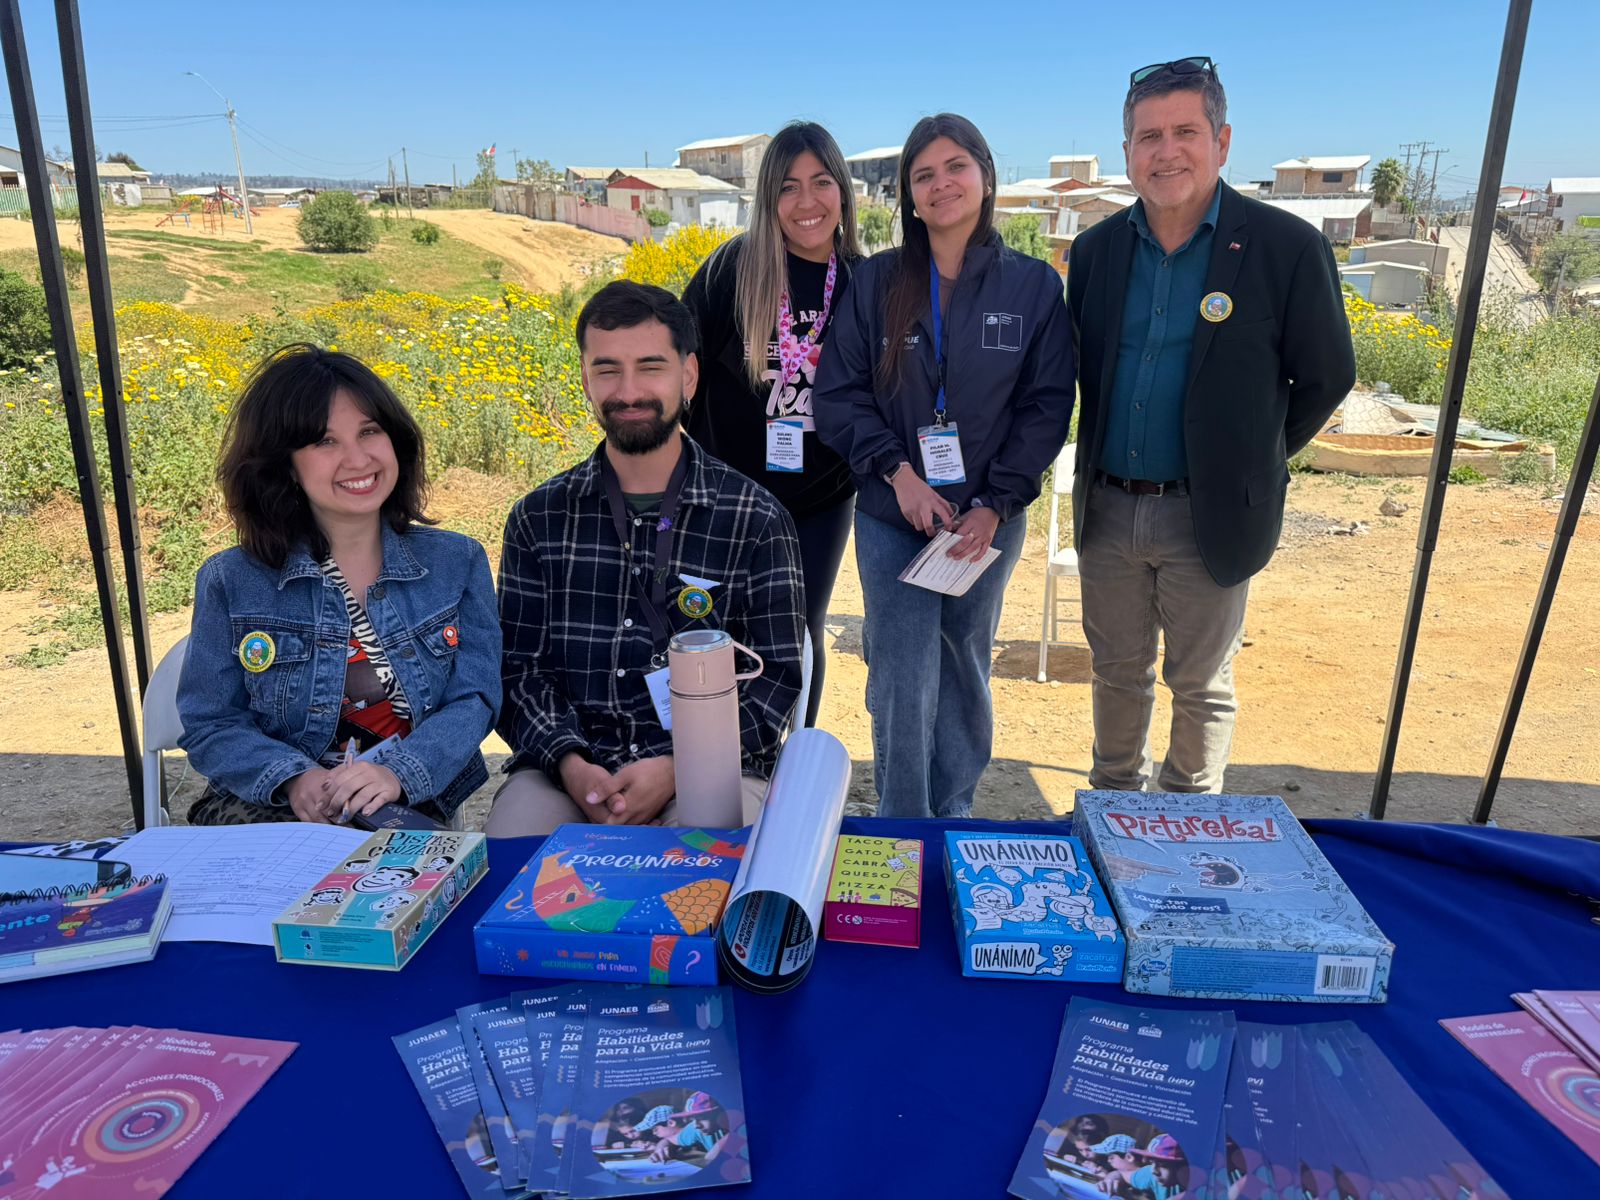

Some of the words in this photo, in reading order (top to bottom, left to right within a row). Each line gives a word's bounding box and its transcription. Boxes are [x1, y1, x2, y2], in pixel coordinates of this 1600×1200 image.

[1106, 812, 1278, 842] Pictureka!
[384, 832, 460, 846] PISTAS
[368, 844, 460, 857] CRUZADAS
[843, 859, 888, 868] CABRA
[841, 870, 890, 878] QUESO
[838, 881, 886, 890] PIZZA
[600, 1006, 638, 1014] JUNAEB
[487, 1016, 525, 1029] JUNAEB
[1090, 1016, 1130, 1031] JUNAEB
[409, 1029, 448, 1047] JUNAEB
[596, 1031, 684, 1046] Habilidades
[598, 1027, 648, 1036] Programa
[596, 1046, 629, 1057] para
[633, 1045, 646, 1053] la
[650, 1041, 682, 1052] Vida
[686, 1039, 710, 1048] (HPV)
[1081, 1035, 1134, 1053] Programa
[1077, 1043, 1170, 1072] Habilidades
[426, 1065, 460, 1084] para
[1073, 1054, 1108, 1070] para
[1112, 1062, 1125, 1073] la
[1131, 1066, 1164, 1082] Vida
[1168, 1076, 1195, 1087] (HPV)
[125, 1074, 174, 1090] ACCIONES
